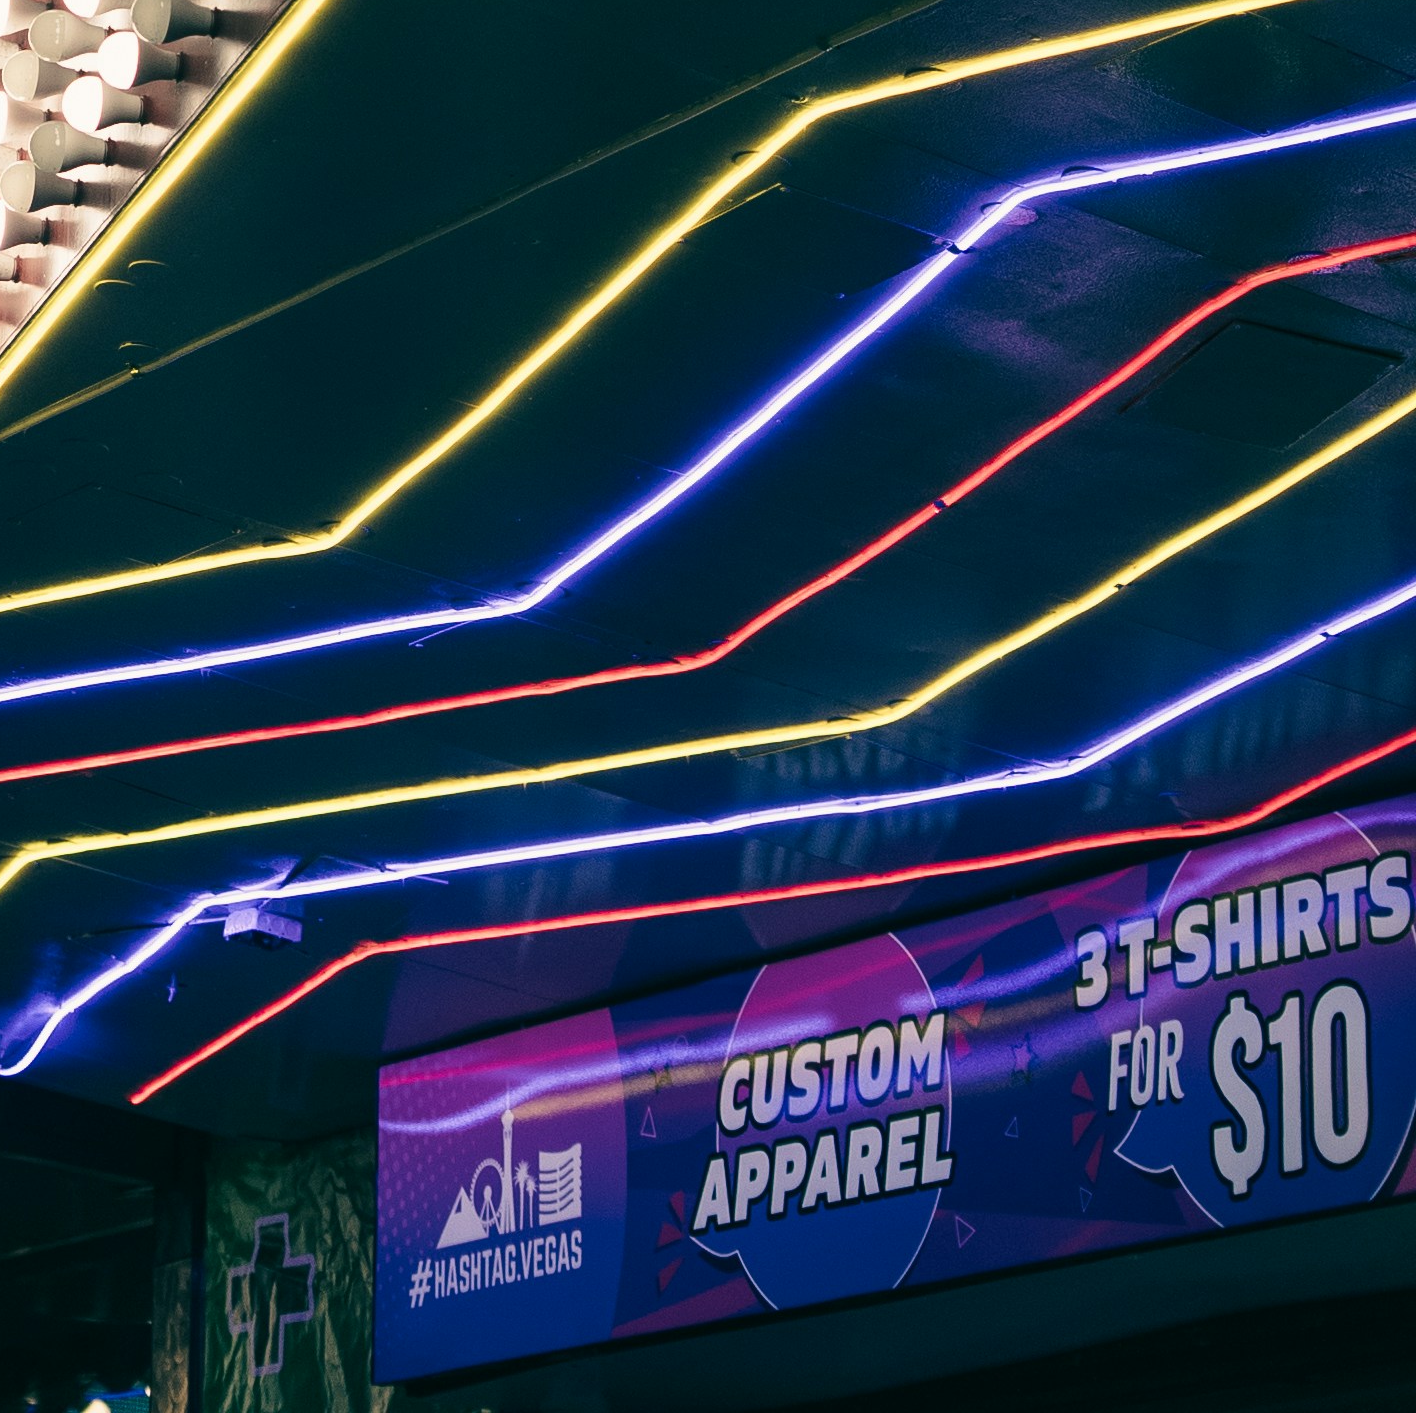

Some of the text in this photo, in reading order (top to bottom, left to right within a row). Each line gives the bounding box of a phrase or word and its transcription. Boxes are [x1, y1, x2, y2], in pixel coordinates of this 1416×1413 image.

[1073, 854, 1413, 1009] 3 T-SHIRTS
[718, 1013, 946, 1132] CUSTOM
[1108, 982, 1370, 1197] FOR $10
[693, 1110, 954, 1231] APPAREL
[407, 1227, 584, 1309] #HASHTAG.VEGAS
